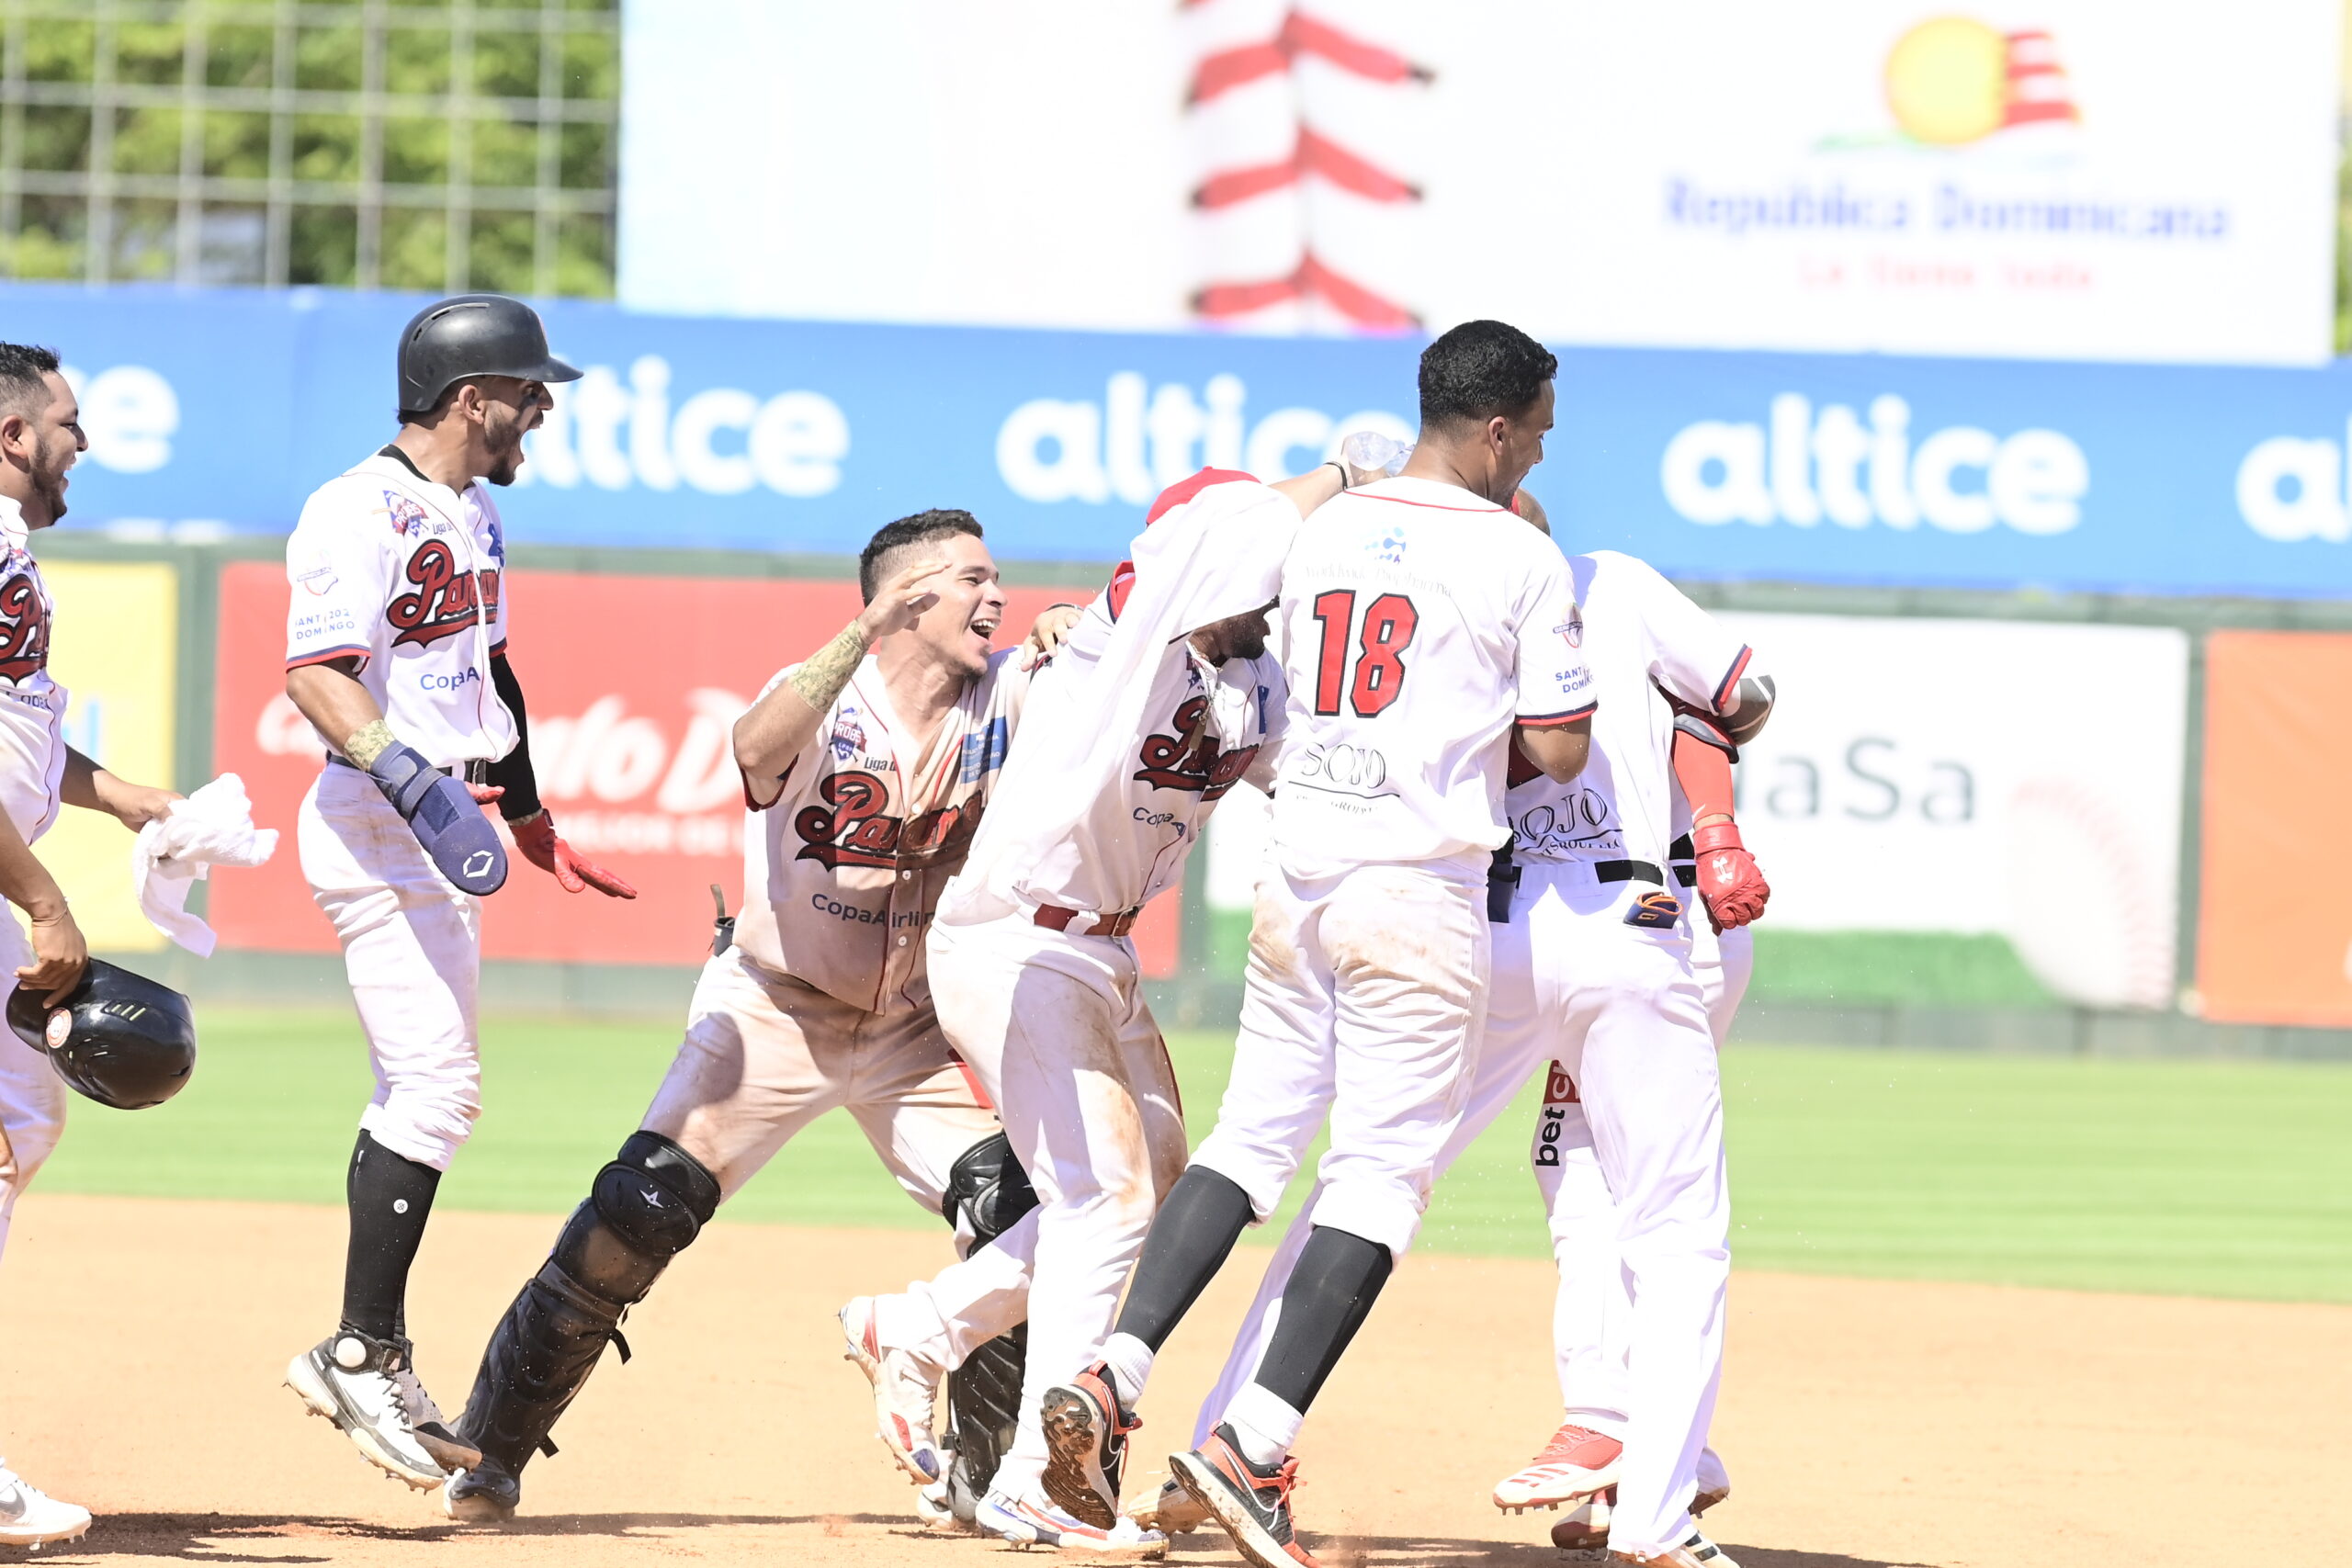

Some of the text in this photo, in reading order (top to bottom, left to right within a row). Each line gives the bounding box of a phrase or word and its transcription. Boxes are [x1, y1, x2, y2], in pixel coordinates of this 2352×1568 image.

[514, 353, 851, 497] ltice
[1661, 392, 2090, 536] altice
[1314, 589, 1419, 718] 18
[1555, 666, 1583, 682] SANT
[864, 757, 888, 772] Liga
